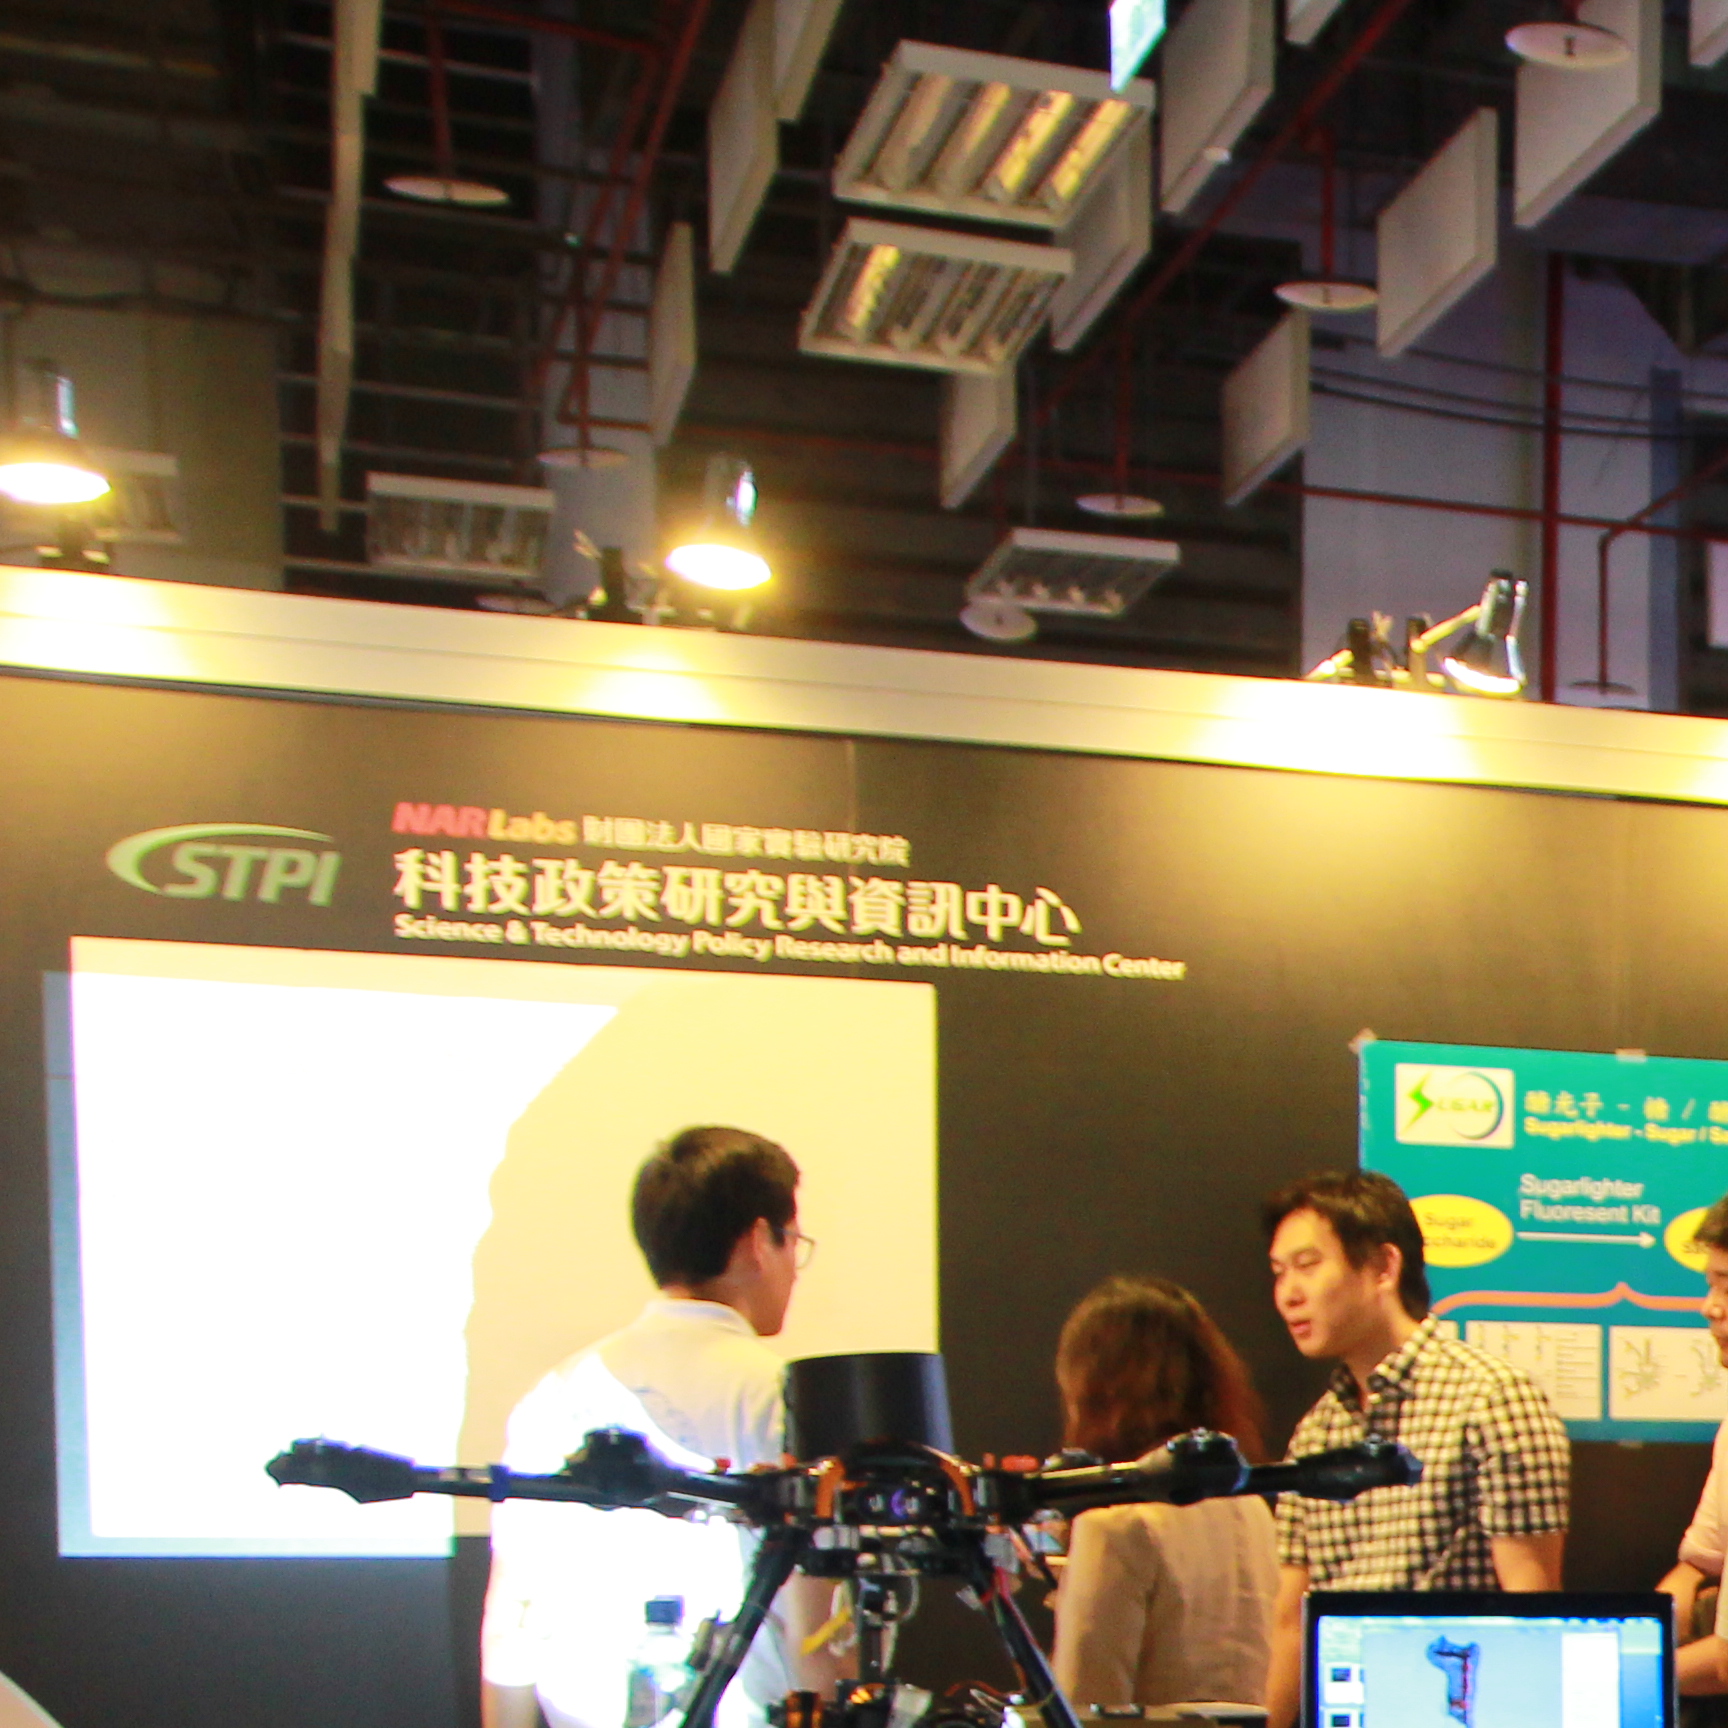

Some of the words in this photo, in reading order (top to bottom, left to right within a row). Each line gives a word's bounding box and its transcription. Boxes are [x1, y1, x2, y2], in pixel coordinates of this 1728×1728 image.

[163, 842, 342, 906] STPI
[393, 847, 1083, 948] 科技政策研究與資訊中心
[395, 913, 503, 942] Science
[506, 919, 530, 945] &
[531, 921, 691, 957] Technology
[692, 930, 772, 962] Policy
[776, 933, 896, 973] Research
[898, 943, 948, 967] and
[951, 944, 1102, 975] Information
[1104, 951, 1188, 980] Center
